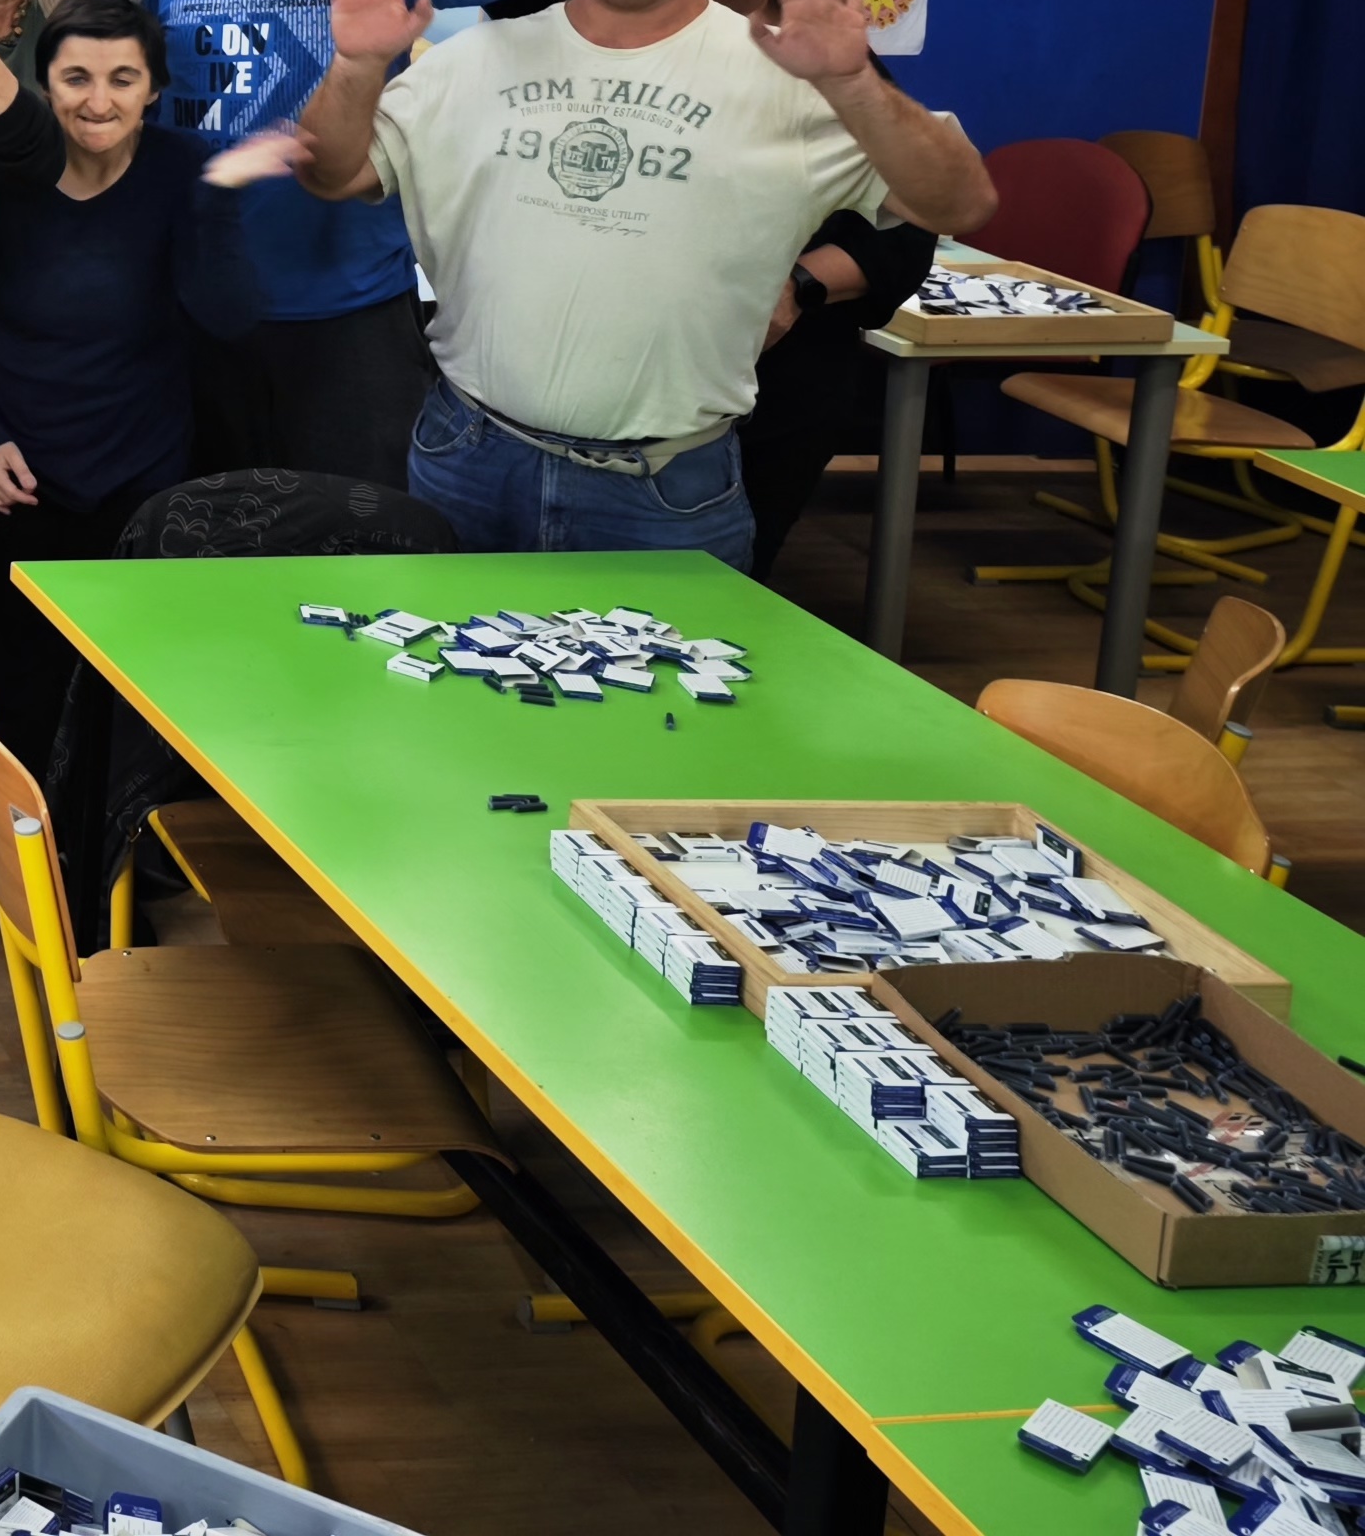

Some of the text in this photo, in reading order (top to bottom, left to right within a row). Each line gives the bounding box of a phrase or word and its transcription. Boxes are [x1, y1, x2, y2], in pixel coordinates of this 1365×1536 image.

[499, 78, 712, 130] TOM TAILOR
[520, 102, 685, 136] TRUSTED QUALITY ESTABLISHED IN
[495, 127, 694, 183] 19 62
[516, 193, 560, 210] GENERAL
[563, 203, 609, 218] PURPOSE
[611, 210, 650, 222] UTILITY
